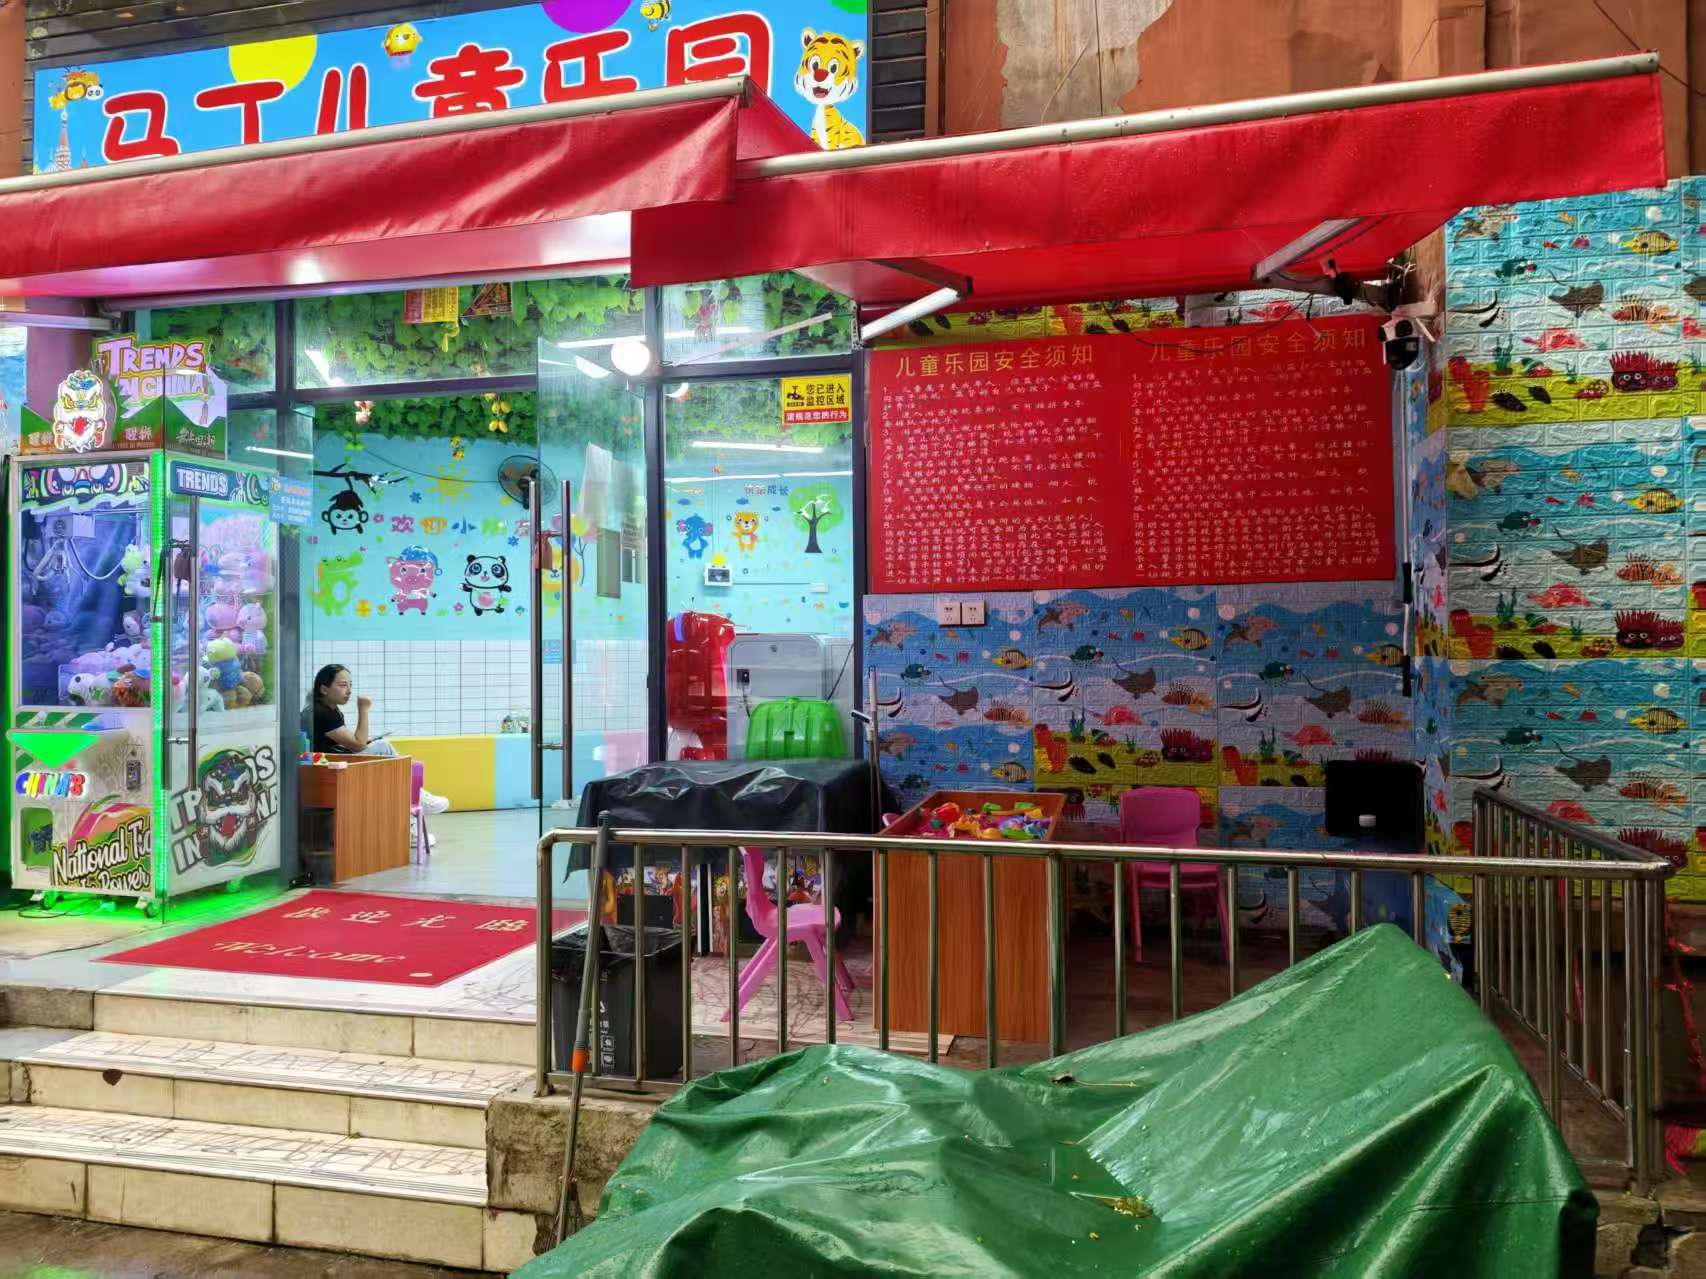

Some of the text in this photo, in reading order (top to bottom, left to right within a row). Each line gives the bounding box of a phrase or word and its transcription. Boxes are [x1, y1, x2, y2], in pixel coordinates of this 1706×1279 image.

[97, 337, 205, 377] TRENDS
[895, 344, 1093, 377] 儿童乐园安全须知
[1149, 328, 1366, 362] 儿童乐园安全须知
[806, 383, 845, 395] 您已进入
[806, 394, 845, 407] 监控区域
[176, 467, 229, 497] TRENDS
[53, 824, 128, 886] National
